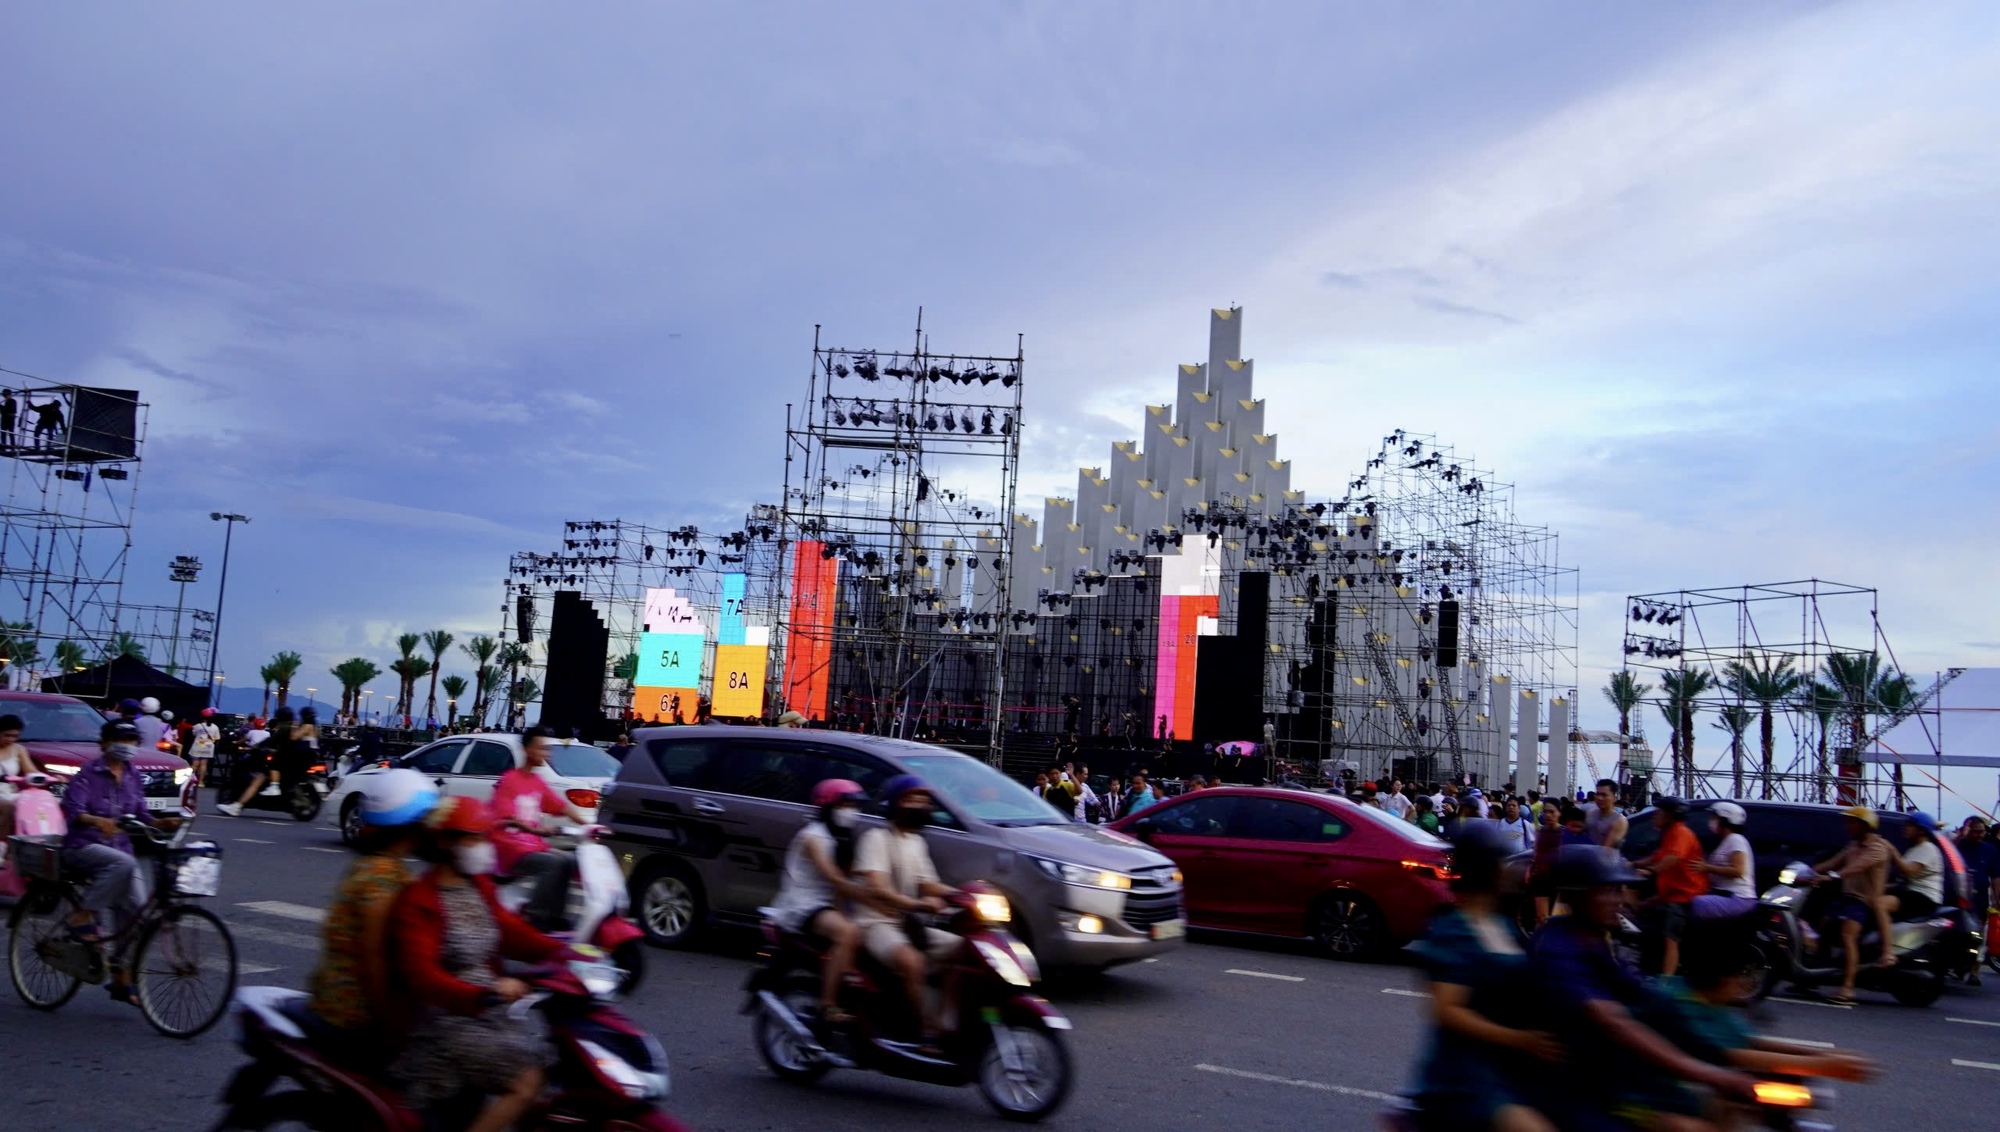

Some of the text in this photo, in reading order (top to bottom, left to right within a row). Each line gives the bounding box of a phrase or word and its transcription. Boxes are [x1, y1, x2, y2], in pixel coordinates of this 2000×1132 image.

[726, 599, 744, 616] 7A
[660, 650, 680, 668] 5A
[729, 671, 749, 689] 8A
[660, 694, 680, 712] 6A
